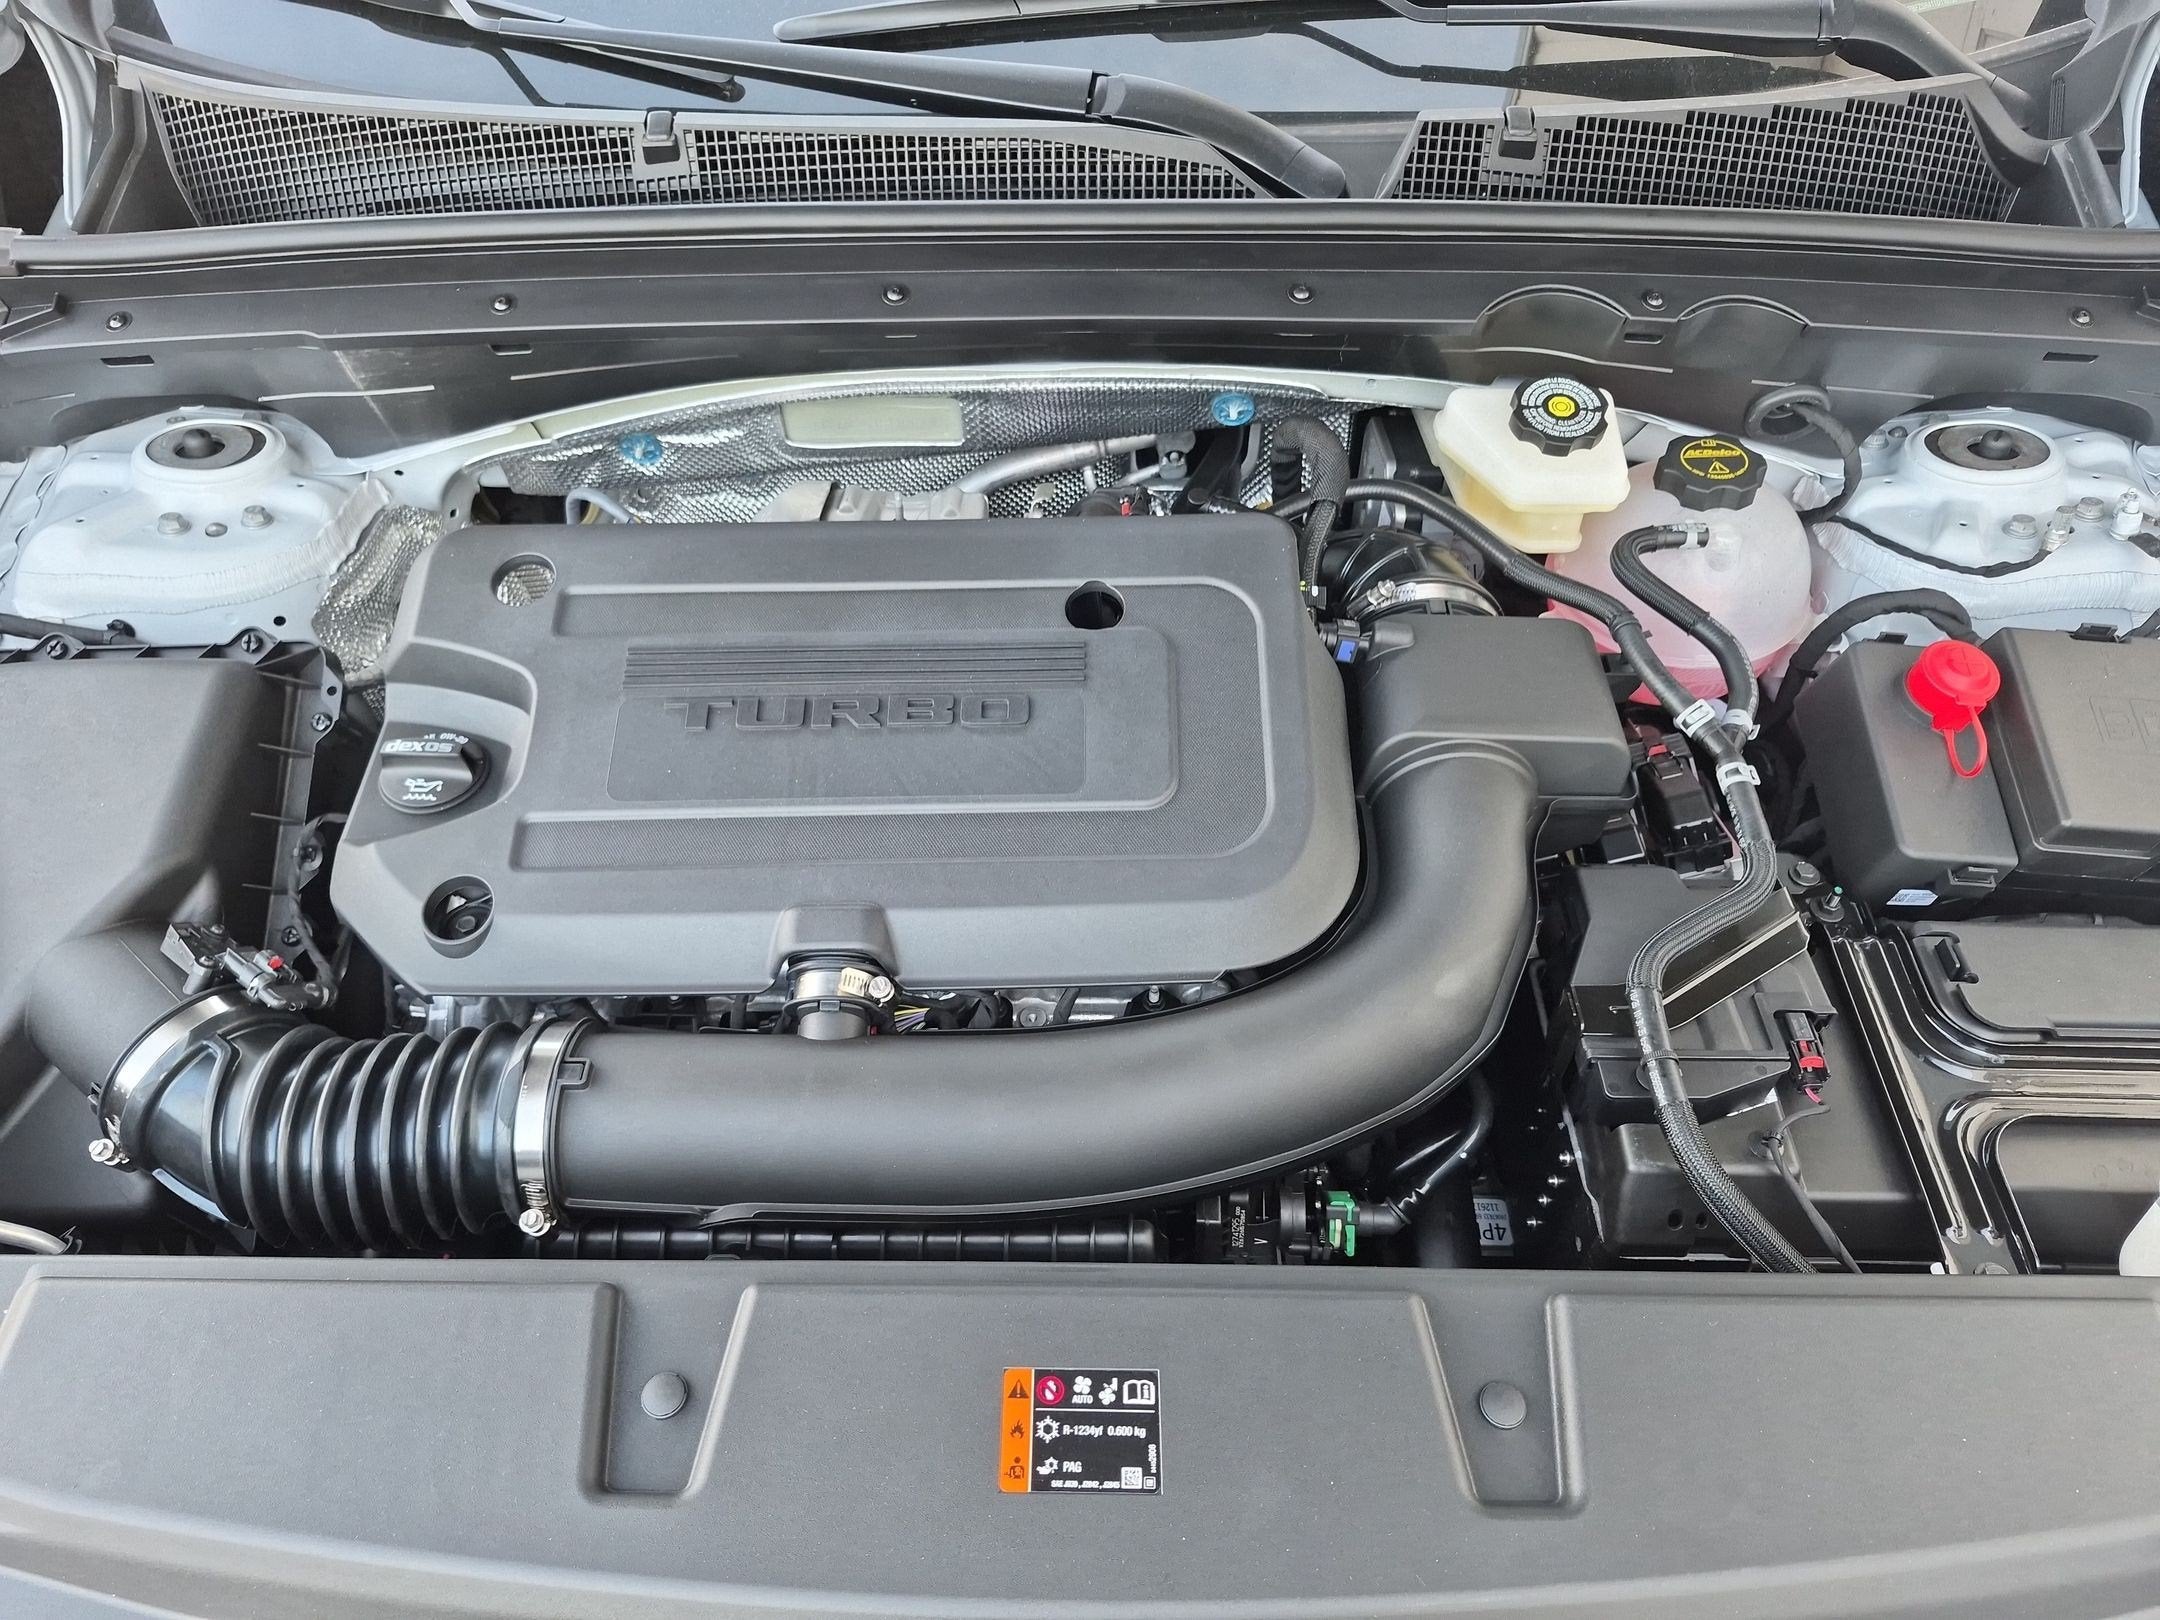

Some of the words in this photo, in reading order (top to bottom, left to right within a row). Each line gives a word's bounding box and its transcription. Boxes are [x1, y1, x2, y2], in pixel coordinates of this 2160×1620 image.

[1684, 449, 1741, 458] ACDelco
[664, 693, 1030, 732] TURBO
[385, 739, 453, 752] dexos
[1071, 1394, 1094, 1404] AUTO
[1062, 1424, 1104, 1438] R-1234yf
[1107, 1425, 1133, 1437] 0.600
[1133, 1426, 1147, 1439] kg
[1062, 1460, 1083, 1473] PAG
